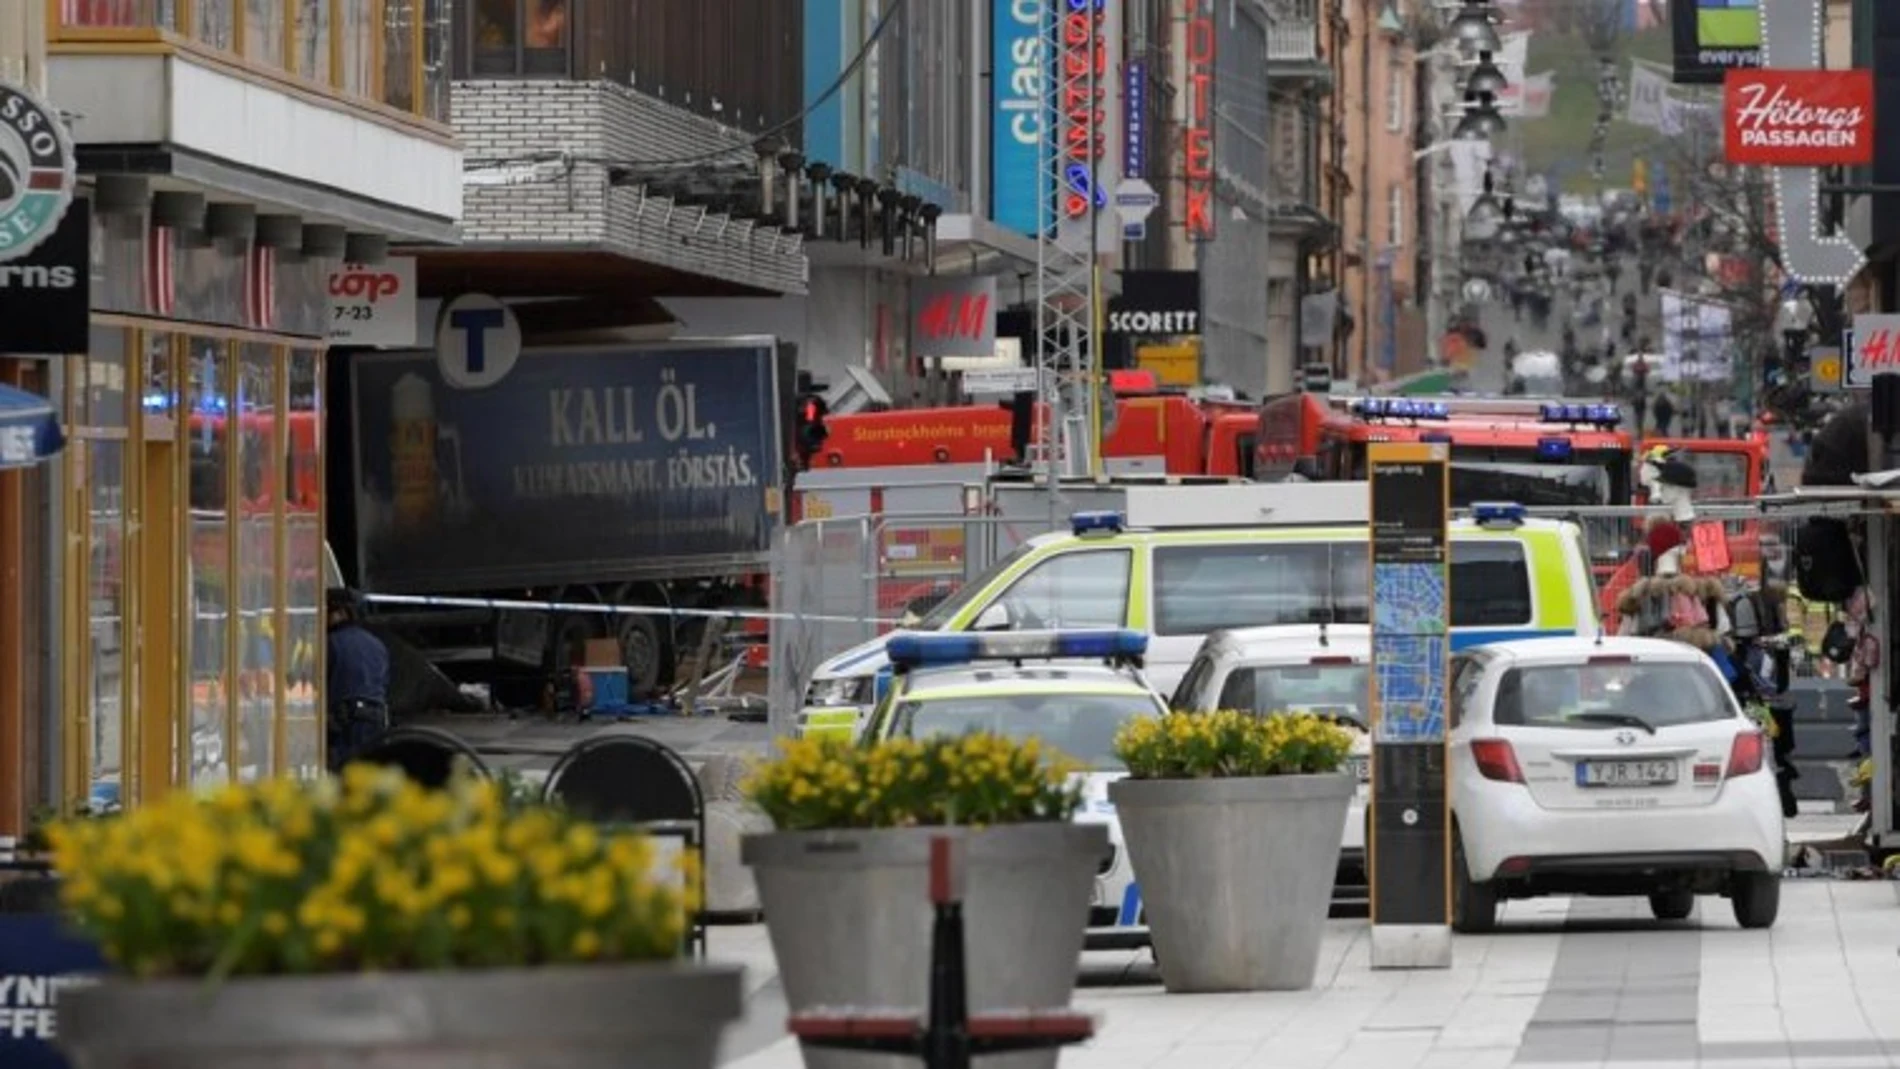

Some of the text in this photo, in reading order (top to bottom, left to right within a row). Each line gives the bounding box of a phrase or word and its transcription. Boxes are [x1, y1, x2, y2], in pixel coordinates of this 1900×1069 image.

[1185, 0, 1216, 234] OTEK
[1736, 82, 1864, 130] Hötorgs
[1741, 128, 1856, 147] PASSAGEN
[334, 306, 373, 320] 7-23
[1109, 310, 1197, 332] SCORETT
[450, 308, 505, 373] T
[549, 367, 716, 445] KALL ÖL.
[668, 445, 757, 489] FÖRSTÅS.
[1592, 763, 1630, 782] YJR
[1637, 763, 1672, 782] 142
